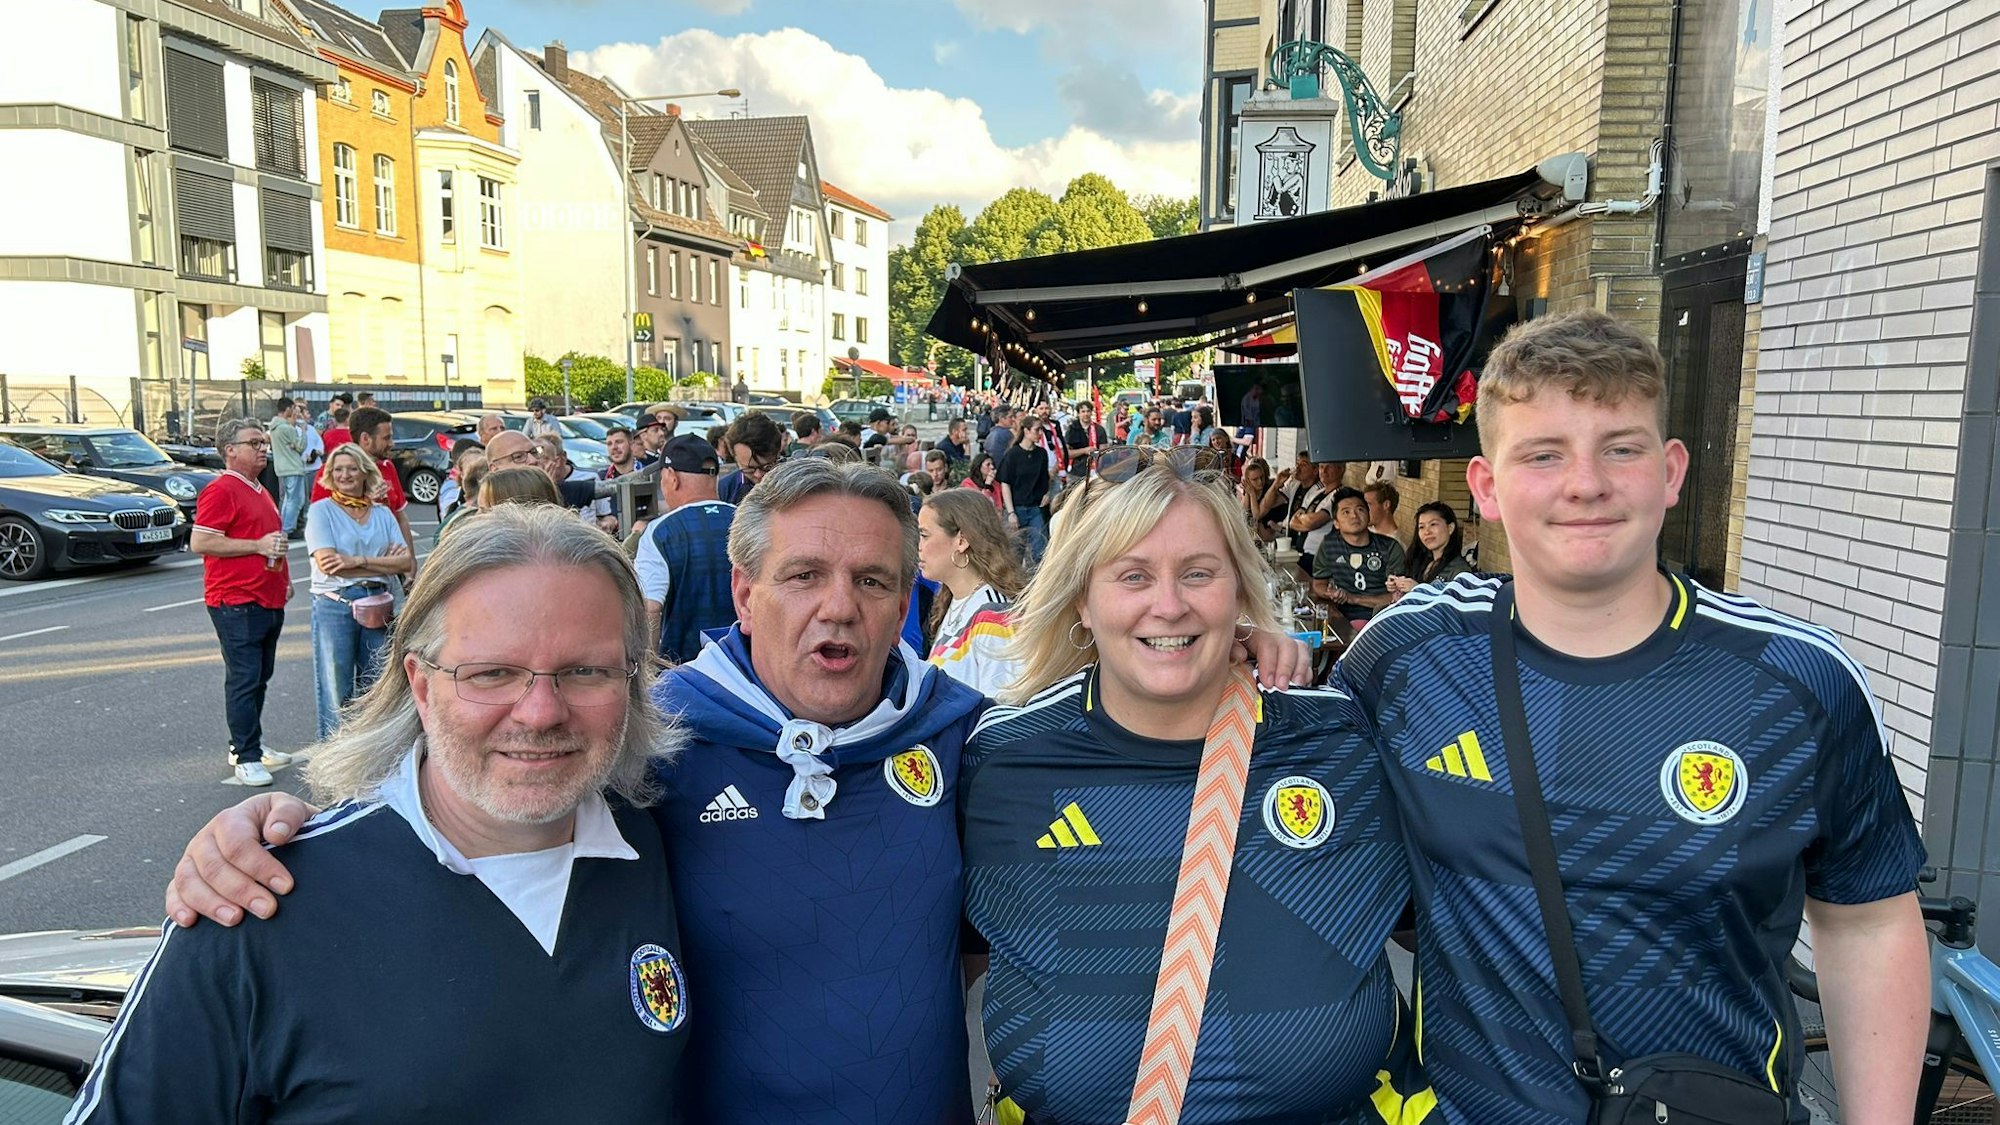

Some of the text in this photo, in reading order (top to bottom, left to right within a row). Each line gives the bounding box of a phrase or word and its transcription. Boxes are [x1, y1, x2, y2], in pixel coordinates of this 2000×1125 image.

[1353, 571, 1367, 591] 8
[1686, 743, 1730, 757] SCOTLAND
[1280, 778, 1316, 787] SCOTLAND
[1671, 799, 1684, 811] EST
[699, 806, 759, 823] adidas
[1720, 808, 1734, 820] 1873
[1275, 831, 1286, 842] EST
